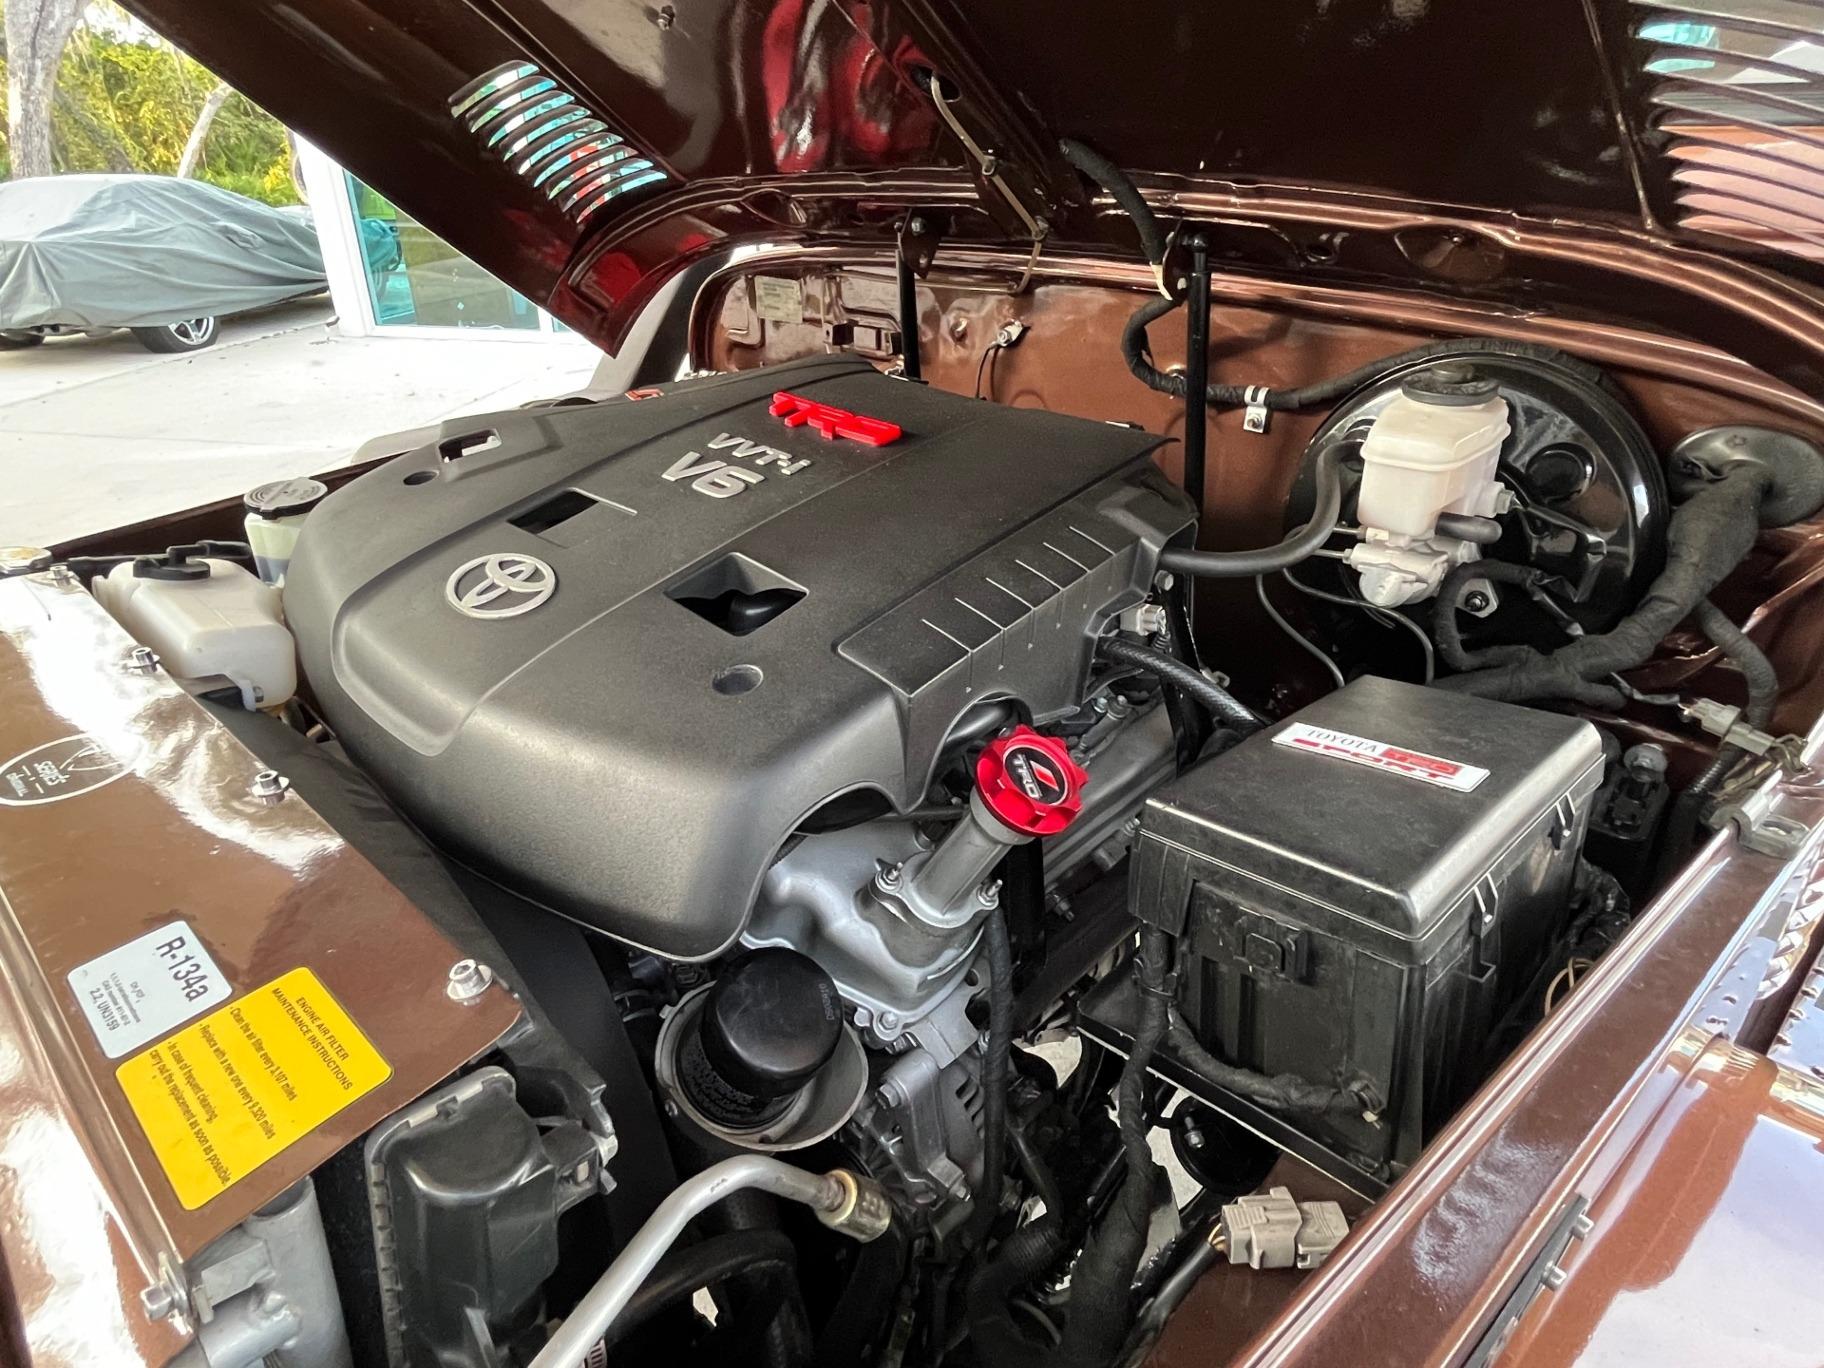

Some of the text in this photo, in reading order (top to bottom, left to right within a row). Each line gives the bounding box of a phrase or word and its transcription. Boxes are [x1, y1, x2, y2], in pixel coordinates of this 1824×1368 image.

[661, 450, 766, 499] V6
[1306, 728, 1378, 754] TOYOTA
[155, 935, 216, 1002] R-134a
[95, 1000, 121, 1031] UN3159
[229, 1006, 248, 1025] Clean
[197, 1023, 220, 1049] Replace
[239, 1021, 253, 1034] the
[245, 1030, 257, 1041] air
[294, 996, 350, 1061] ENGINE AIR FILTER
[250, 1037, 267, 1054] filter
[269, 987, 354, 1091] MAINTENANCE INSTRUCTIONS
[146, 1048, 164, 1067] carry
[170, 1049, 185, 1065] case
[212, 1045, 227, 1060] with
[256, 1051, 275, 1070] every
[156, 1062, 171, 1076] out
[178, 1061, 191, 1071] of
[222, 1062, 236, 1077] new
[162, 1071, 177, 1086] the
[180, 1068, 204, 1097] frequent
[229, 1074, 243, 1088] one
[234, 1085, 254, 1106] every
[280, 1081, 299, 1101] miles
[165, 1081, 197, 1123] replacement
[192, 1127, 209, 1147] soon
[258, 1118, 277, 1140] miles
